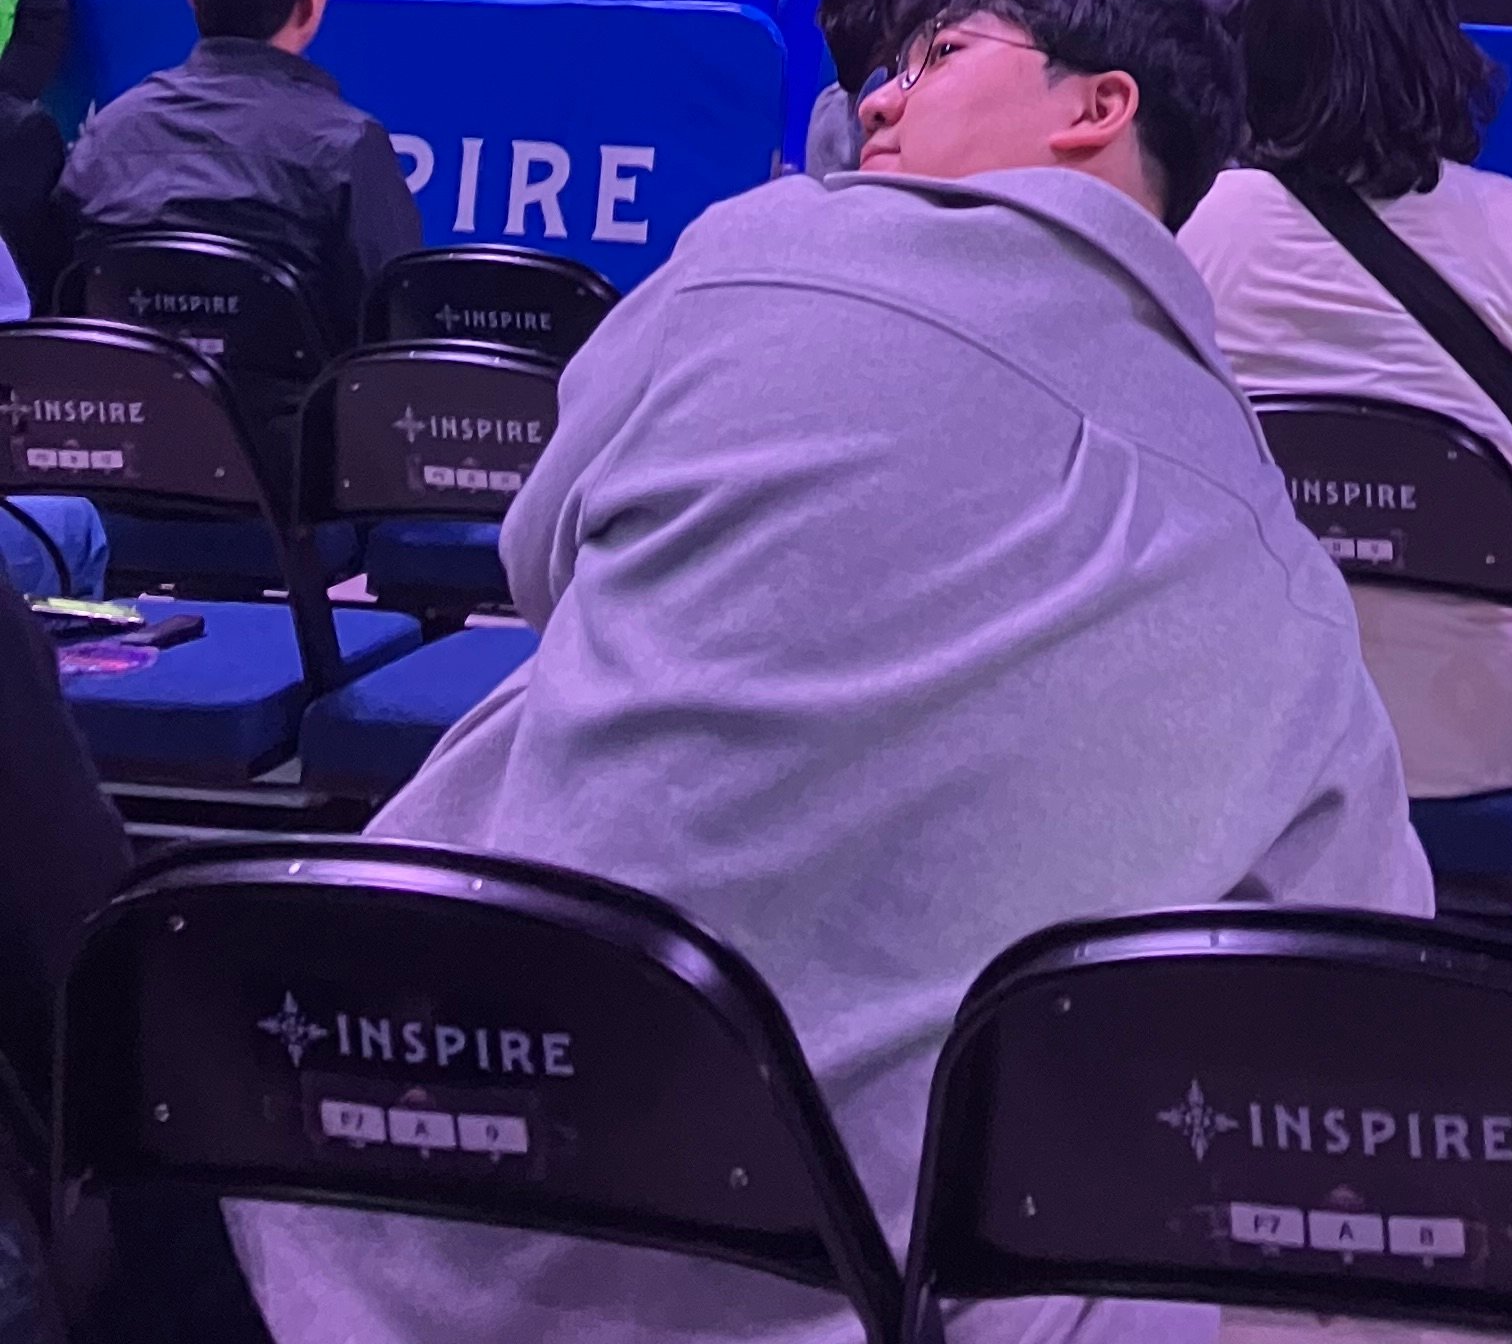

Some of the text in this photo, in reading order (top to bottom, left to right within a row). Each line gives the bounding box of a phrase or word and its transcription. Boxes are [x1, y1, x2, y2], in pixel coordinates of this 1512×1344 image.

[389, 132, 655, 244] PIRE
[154, 293, 240, 313] INSPIRE
[464, 309, 552, 331] INSPIRE
[33, 398, 145, 424] INSPIRE
[430, 415, 542, 444] INSPIRE
[1291, 477, 1417, 510] INSPIRE
[337, 1013, 575, 1076] INSPIRE
[1338, 1220, 1354, 1241] A
